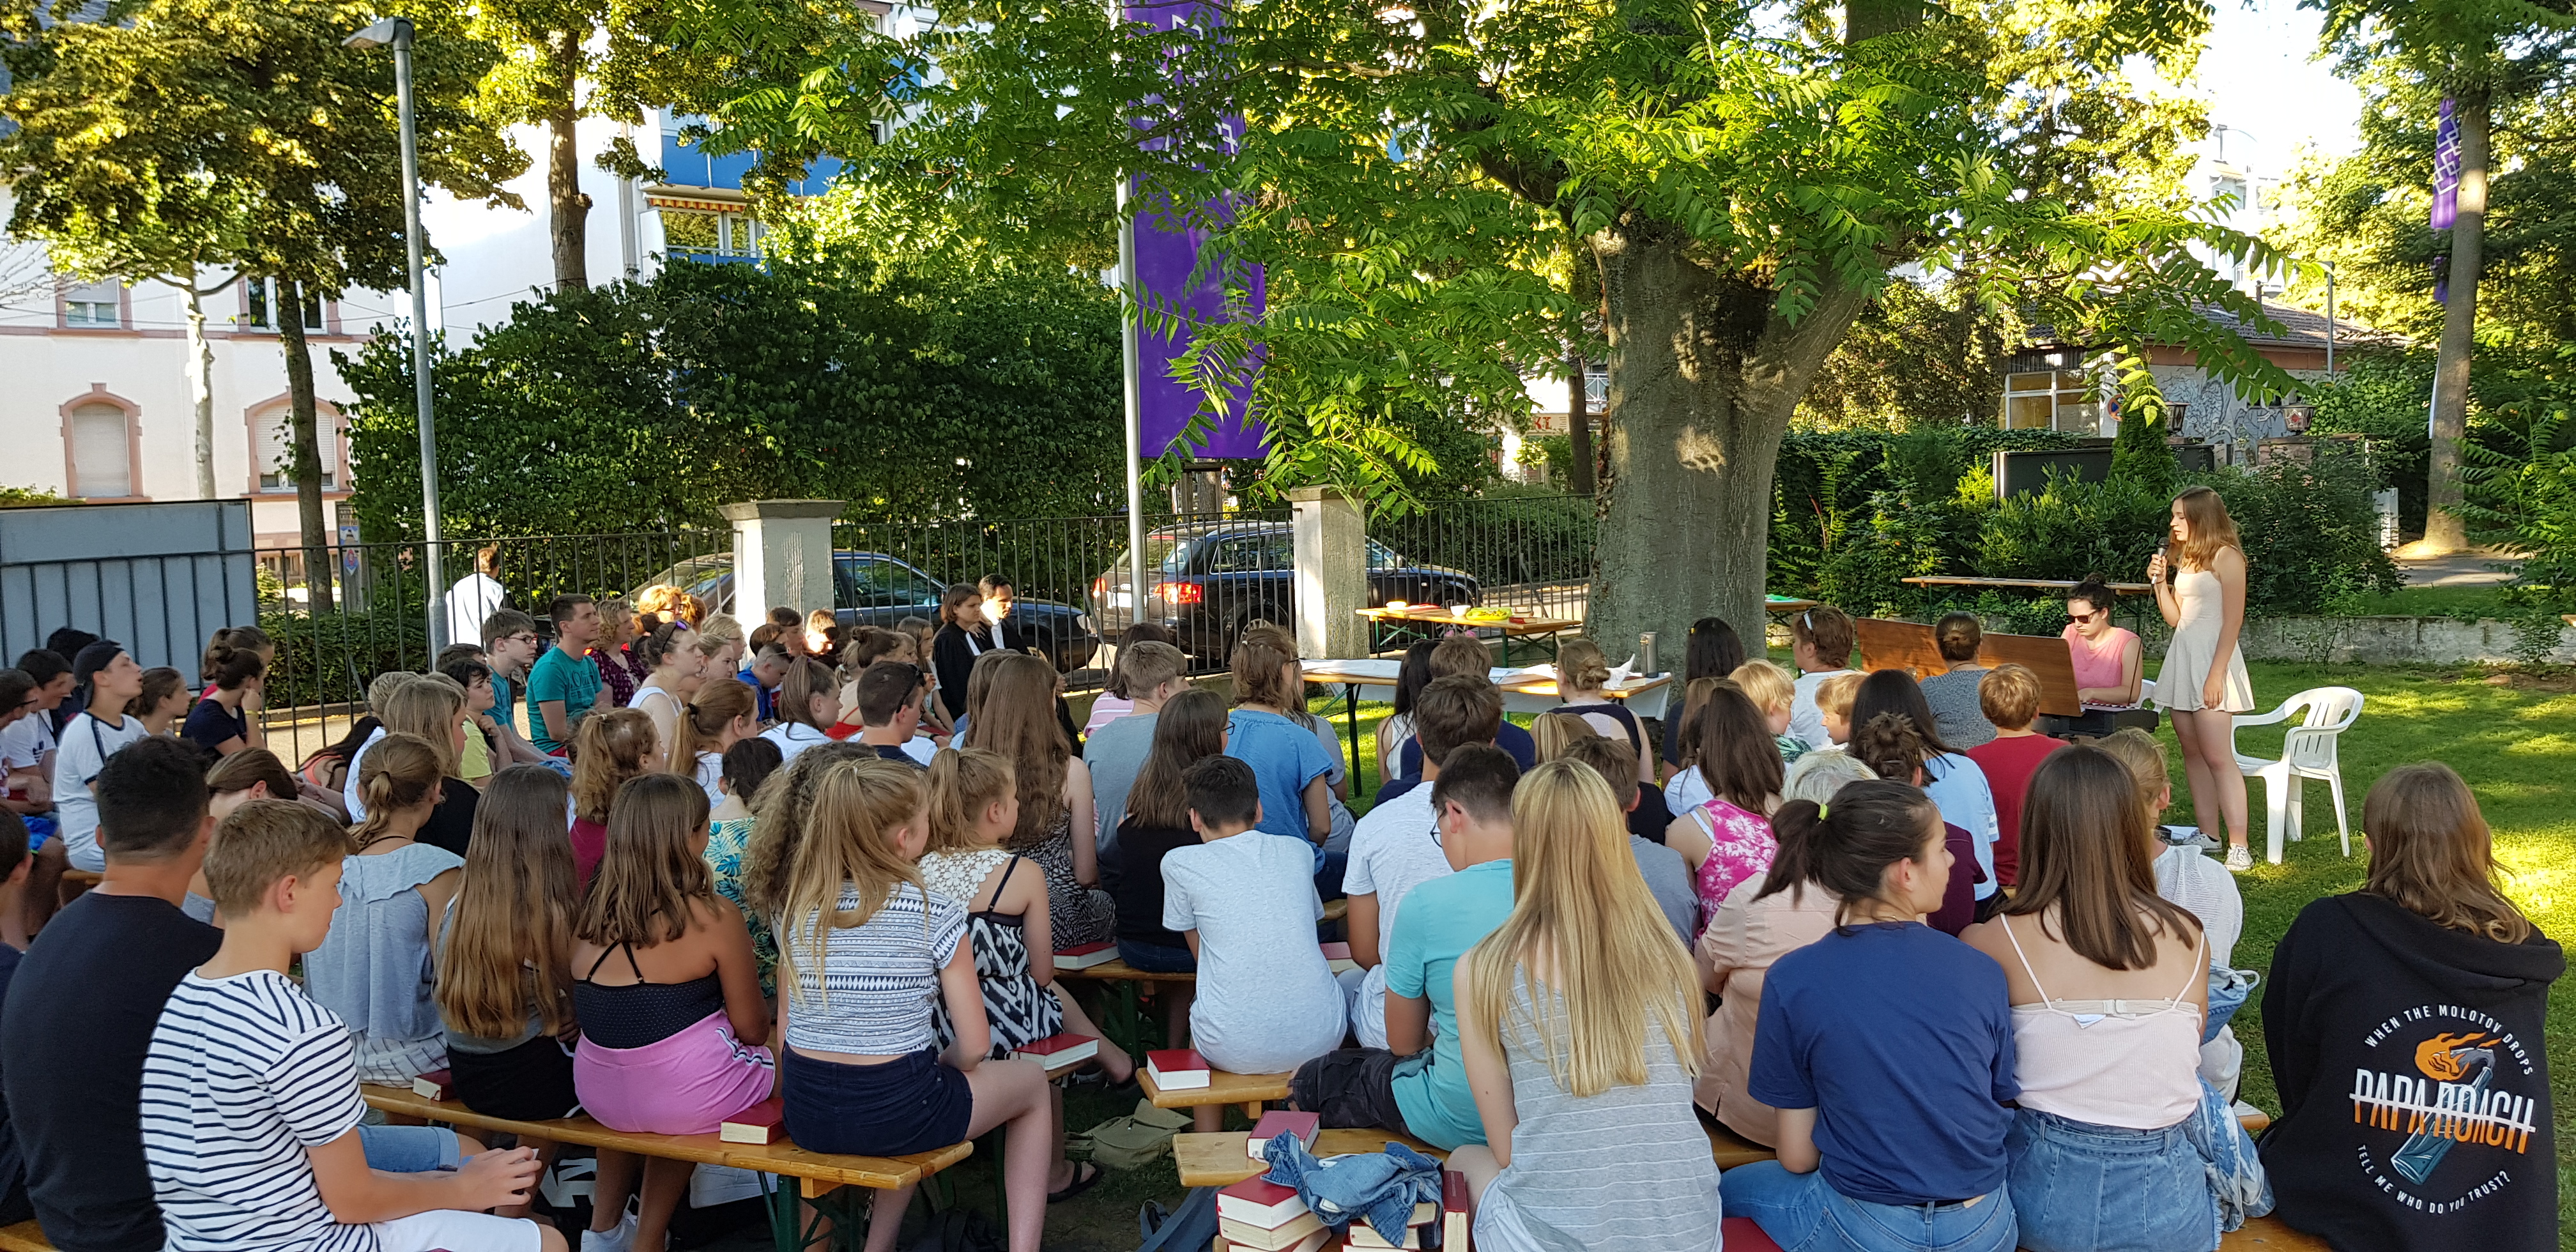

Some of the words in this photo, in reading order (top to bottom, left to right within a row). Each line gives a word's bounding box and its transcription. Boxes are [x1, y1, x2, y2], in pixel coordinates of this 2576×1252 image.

[2364, 1016, 2400, 1048] WHEN
[2403, 1005, 2431, 1022] THE
[2439, 1004, 2502, 1033] MOLOTOV
[2502, 1033, 2533, 1075] DROPS
[2354, 1068, 2426, 1135] PAPA
[2433, 1081, 2534, 1154] ROACH
[2358, 1144, 2374, 1174] TELL
[2374, 1175, 2394, 1193] ME
[2396, 1190, 2423, 1210] WHO
[2429, 1202, 2444, 1214] DO
[2449, 1196, 2465, 1212] YOU
[2467, 1170, 2511, 1201] TRUST?
